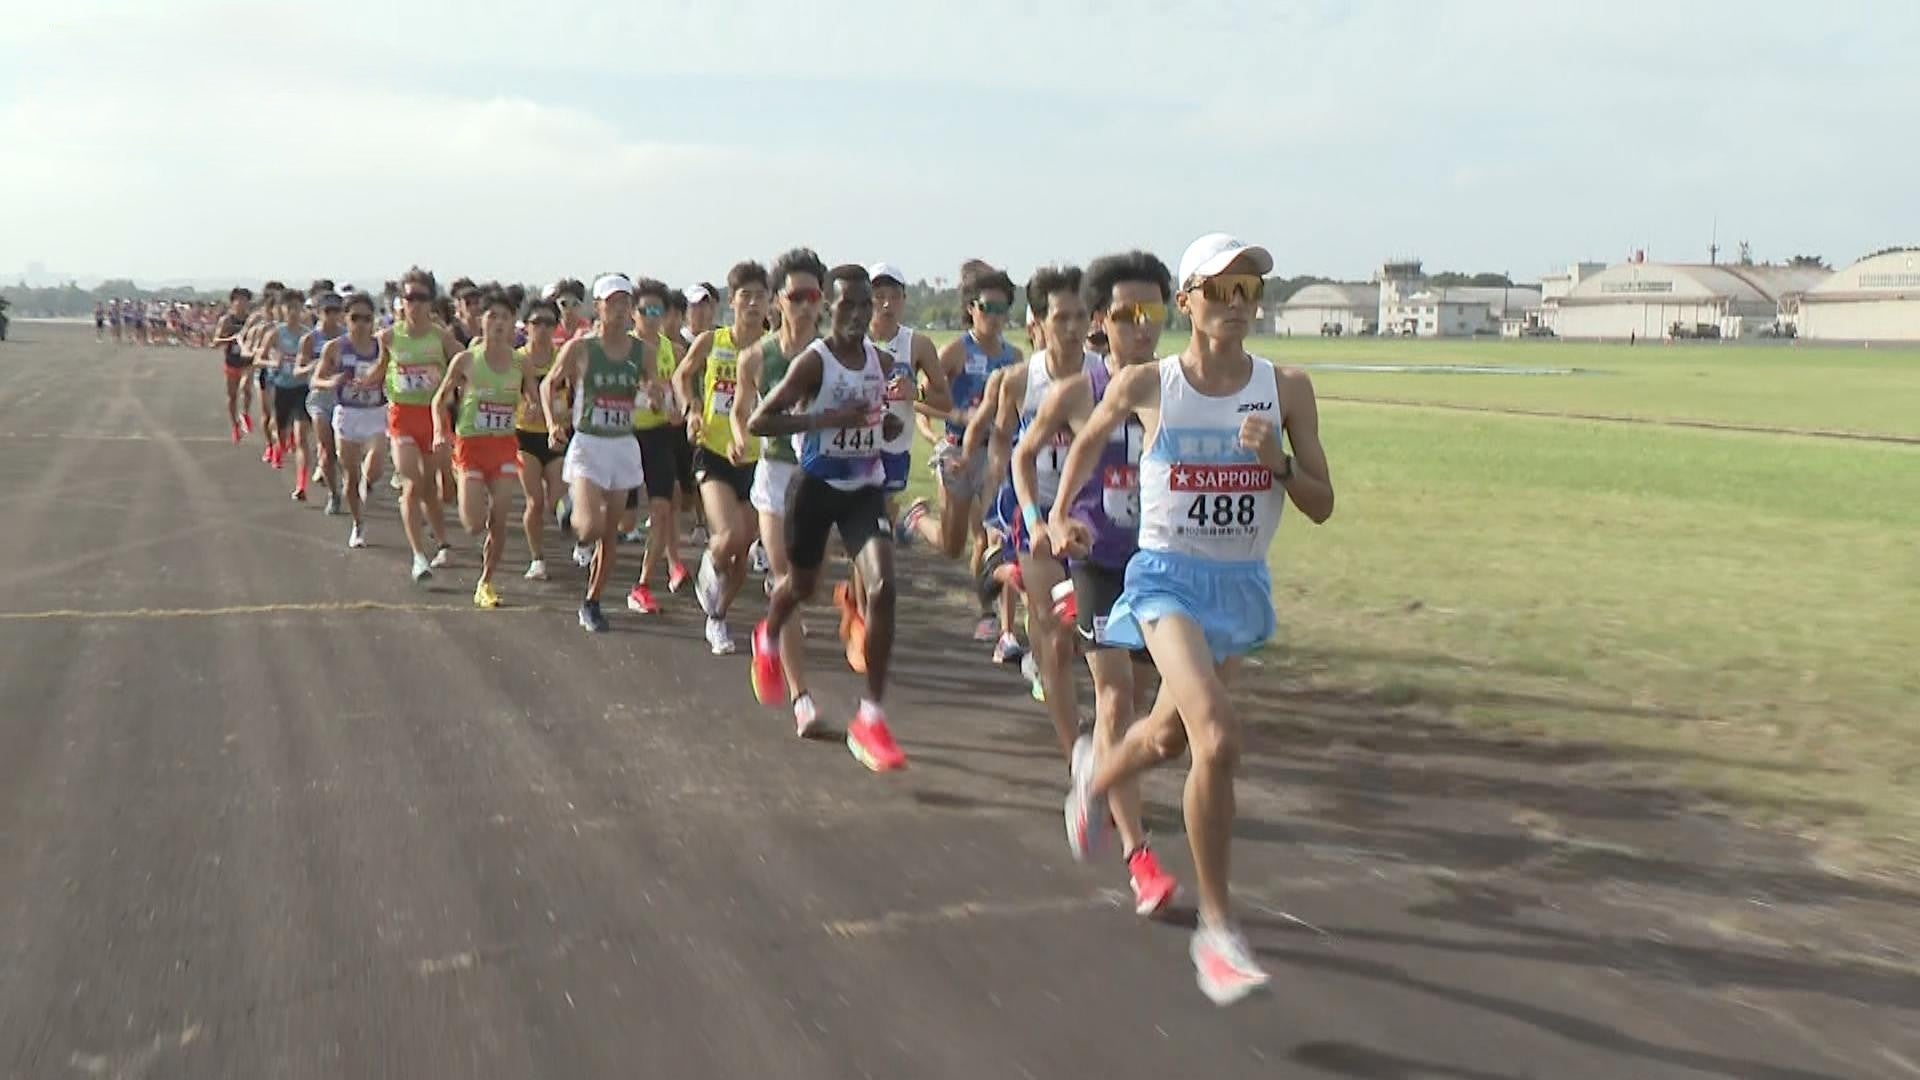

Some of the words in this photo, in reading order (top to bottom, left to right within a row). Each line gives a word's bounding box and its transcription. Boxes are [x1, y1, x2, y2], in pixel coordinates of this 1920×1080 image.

[1237, 402, 1272, 413] 2XU
[832, 427, 874, 450] 444
[1195, 469, 1270, 488] SAPPORO
[1187, 494, 1255, 527] 488
